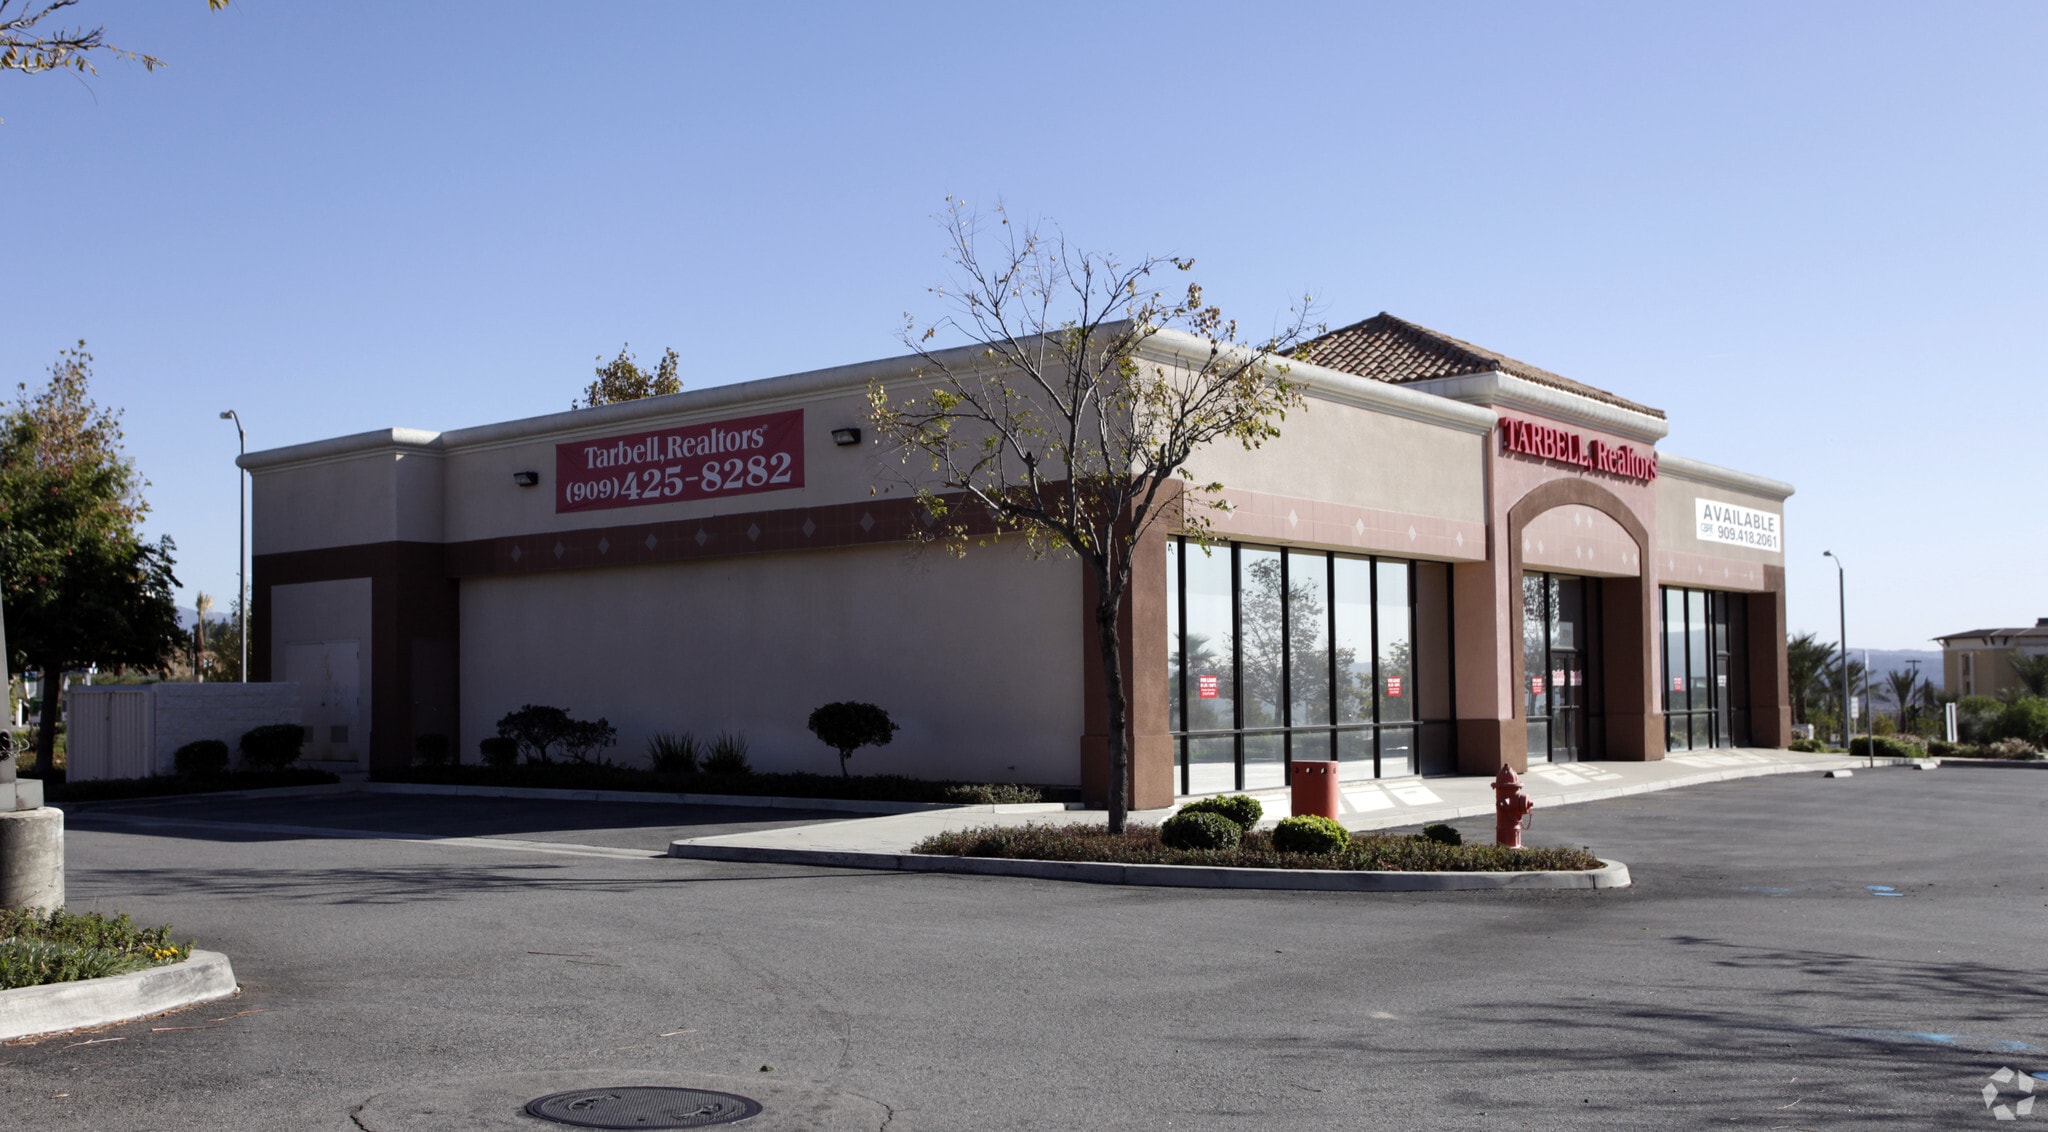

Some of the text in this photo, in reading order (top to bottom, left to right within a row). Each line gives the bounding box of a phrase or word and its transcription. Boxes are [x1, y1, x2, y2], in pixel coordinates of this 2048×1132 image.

[584, 435, 665, 470] Tarbell,
[1503, 417, 1658, 482] TARBELL, Realtors
[1703, 504, 1775, 533] AVAILABLE
[1717, 525, 1777, 549] 909.418.2061
